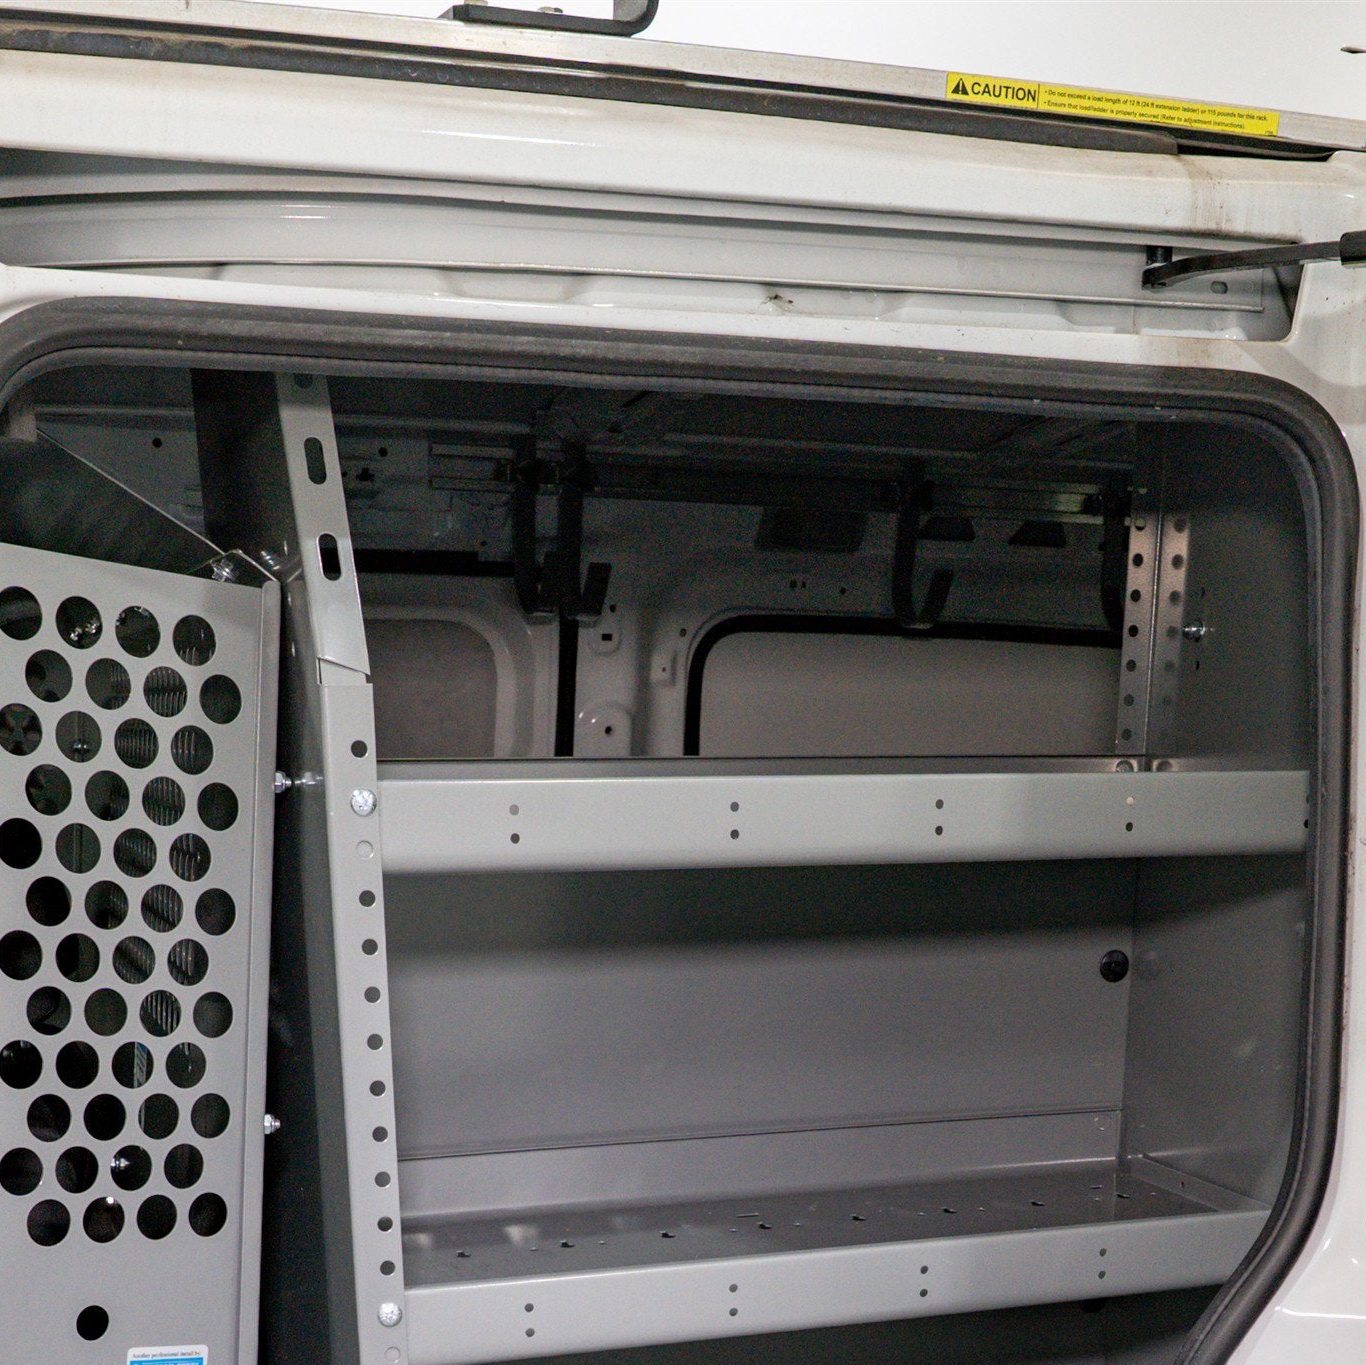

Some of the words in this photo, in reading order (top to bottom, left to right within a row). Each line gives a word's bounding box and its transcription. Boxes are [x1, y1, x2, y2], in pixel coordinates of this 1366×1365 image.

[971, 82, 1036, 102] CAUTION
[1048, 100, 1066, 108] Ensure
[1116, 109, 1137, 117] properly
[1139, 111, 1159, 119] secured
